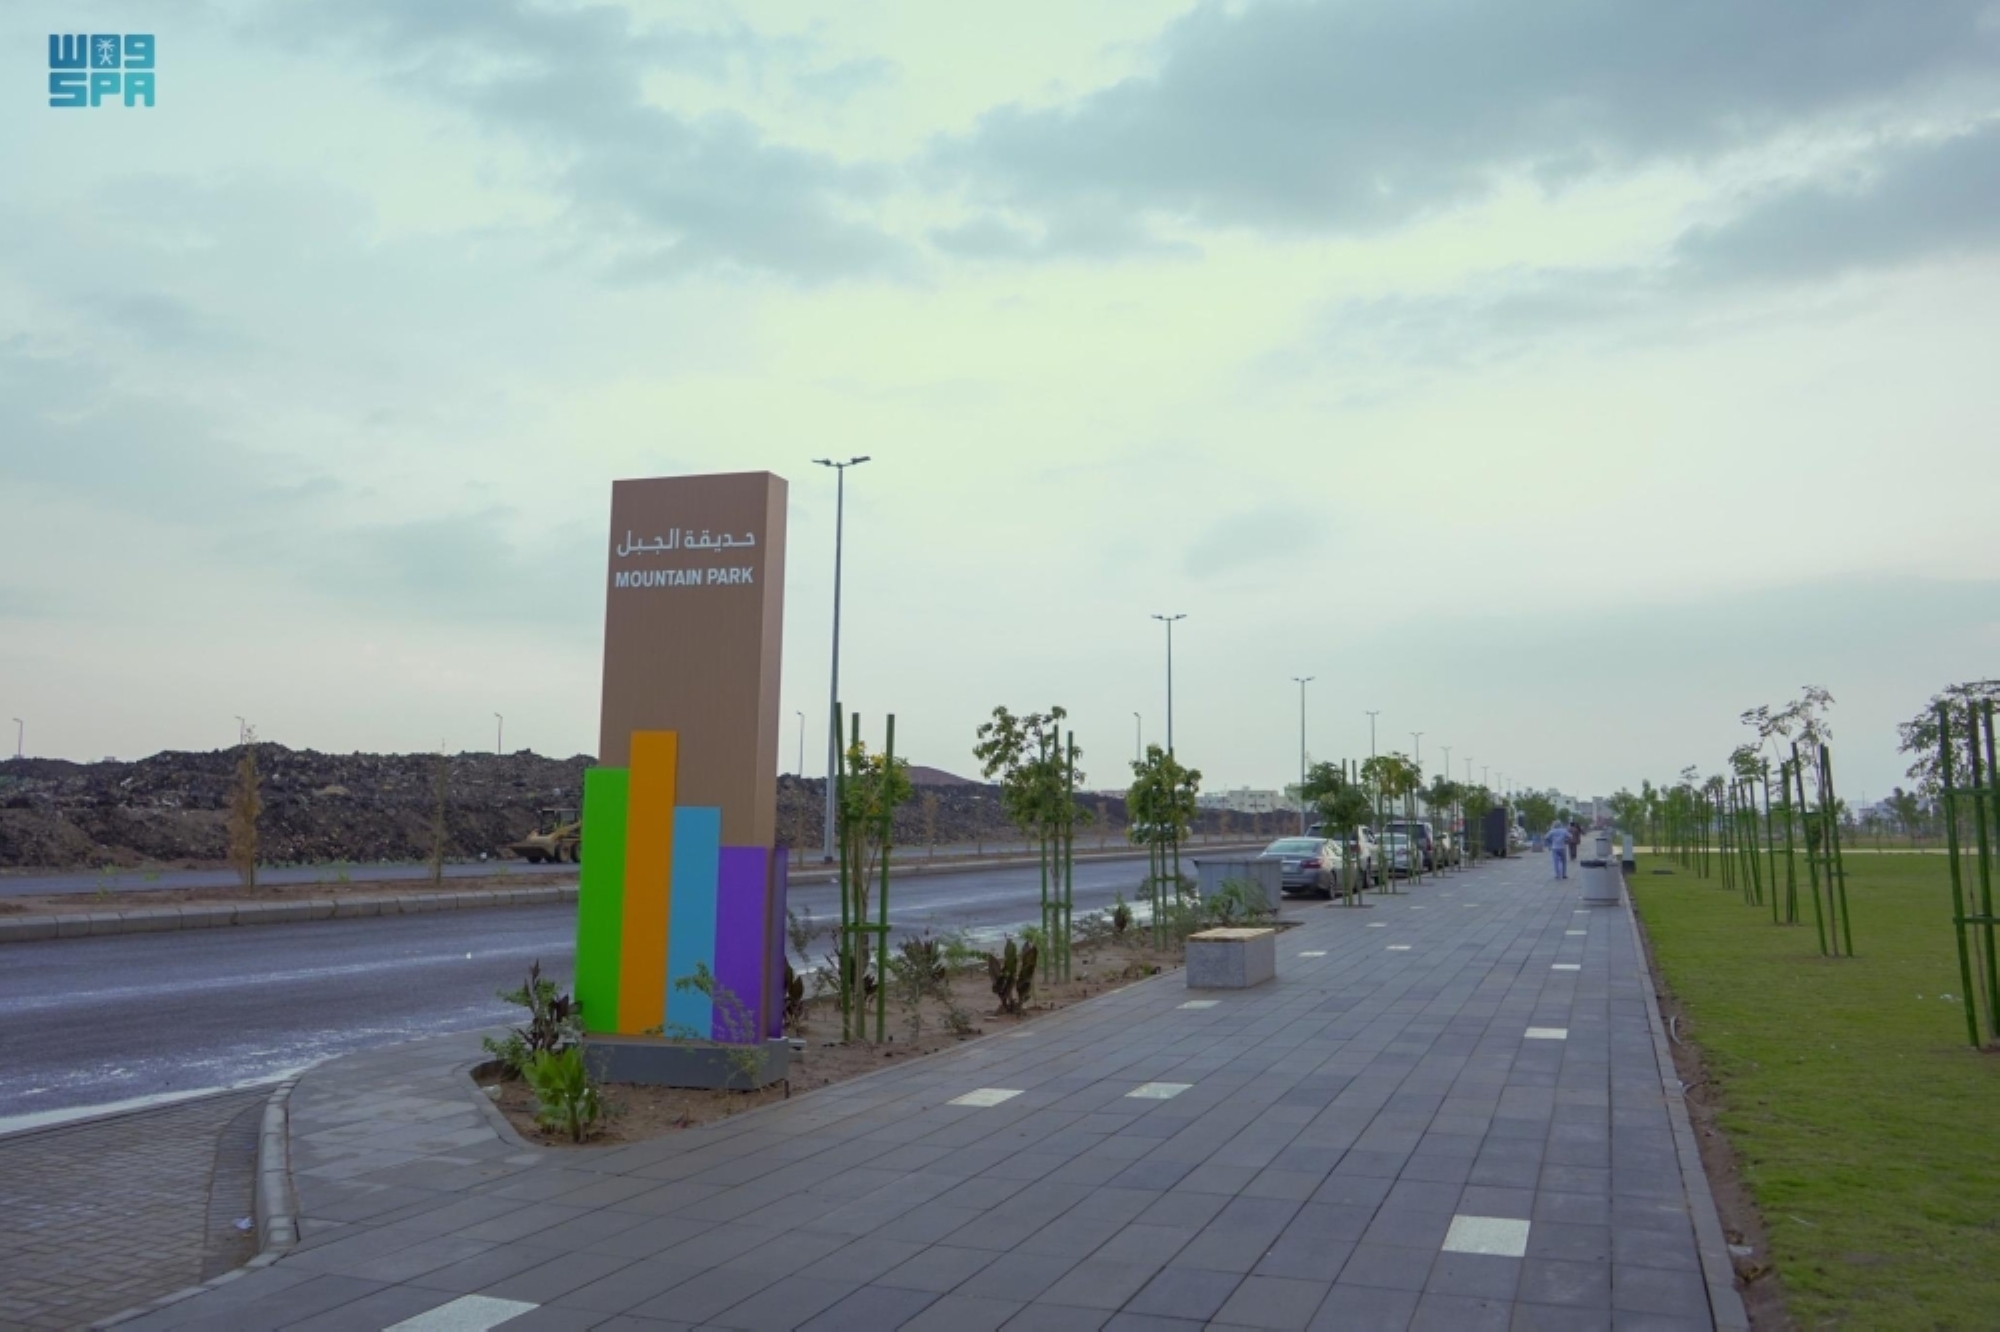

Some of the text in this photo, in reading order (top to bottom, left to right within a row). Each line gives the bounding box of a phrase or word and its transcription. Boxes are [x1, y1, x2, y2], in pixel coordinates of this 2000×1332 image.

[616, 528, 755, 557] حديقة الجبل
[615, 566, 754, 588] MOUNTAIN PARK
